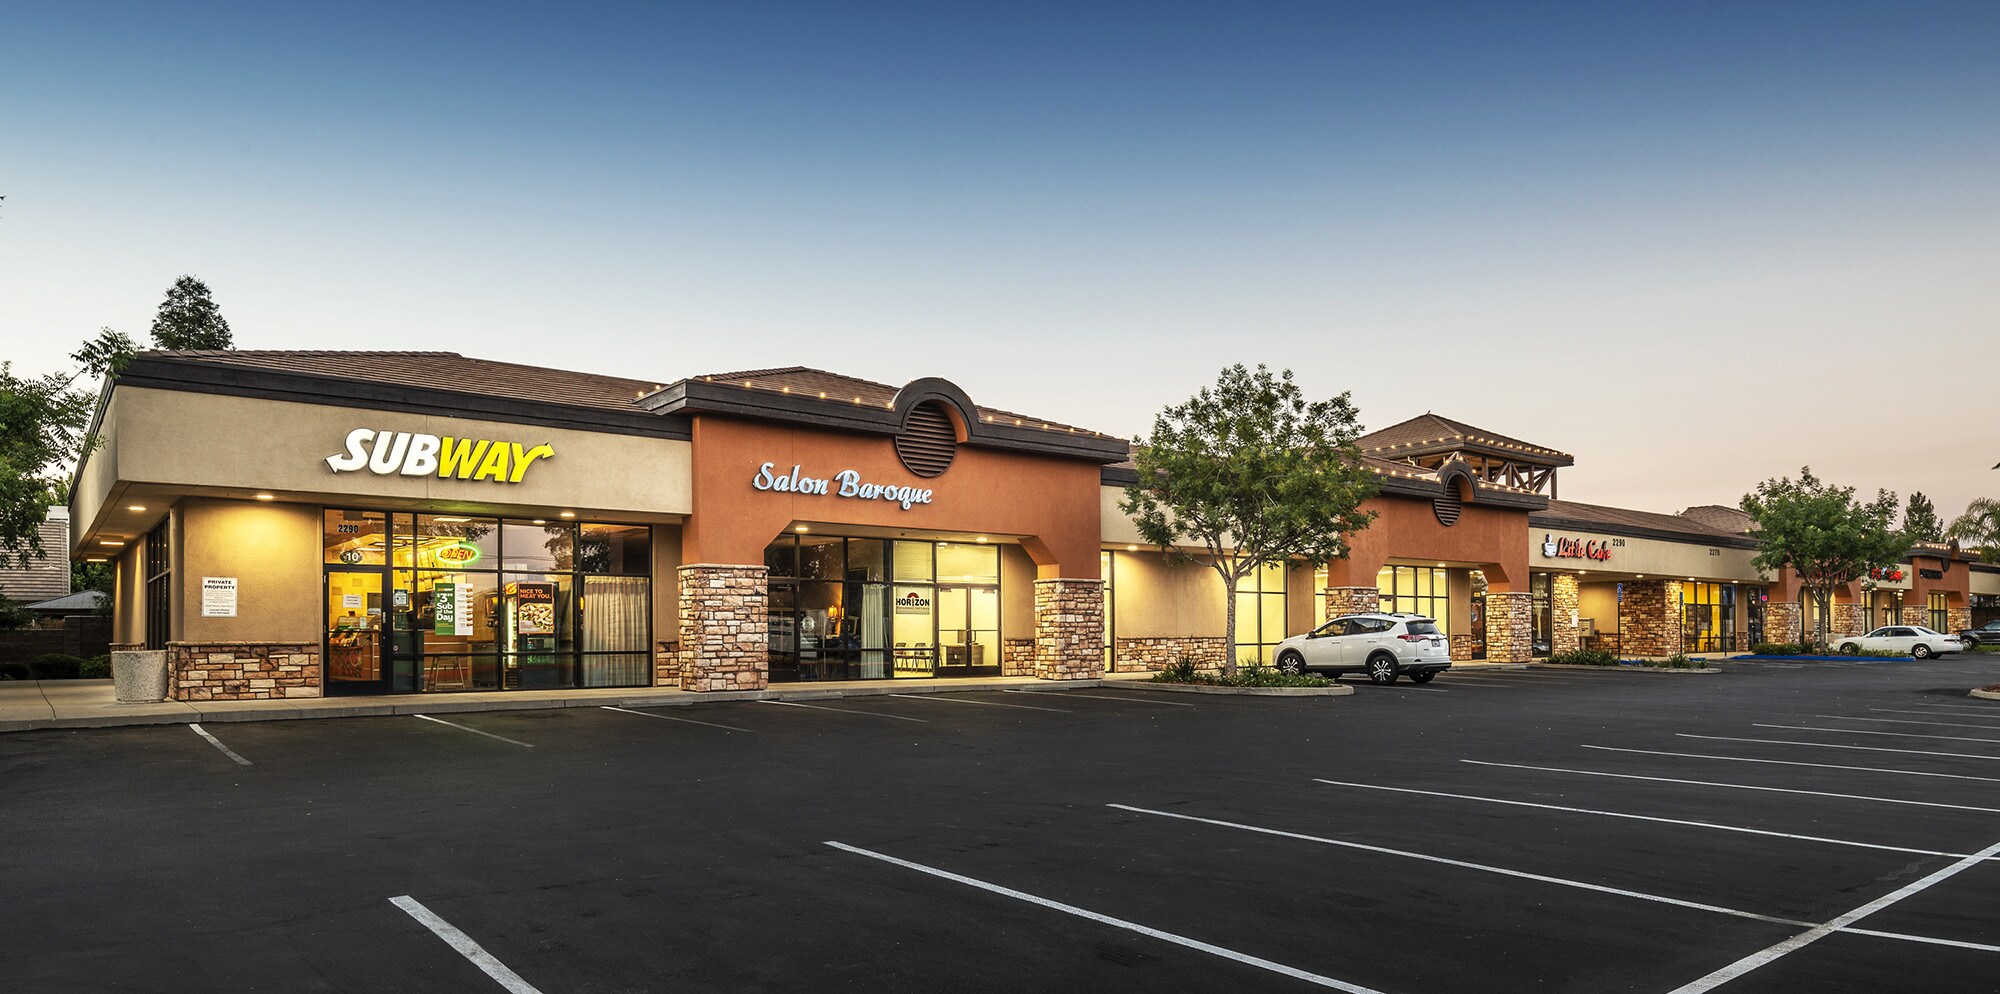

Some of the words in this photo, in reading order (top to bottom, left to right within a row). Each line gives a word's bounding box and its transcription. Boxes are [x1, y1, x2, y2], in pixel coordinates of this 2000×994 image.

[325, 428, 556, 483] SUBWAY
[753, 461, 828, 495] Salon
[833, 469, 933, 510] Baroque
[338, 524, 359, 533] 2290
[441, 549, 474, 560] OPEN
[1587, 539, 1612, 562] Cafe
[896, 598, 930, 607] HORIZON
[436, 613, 453, 622] Day
